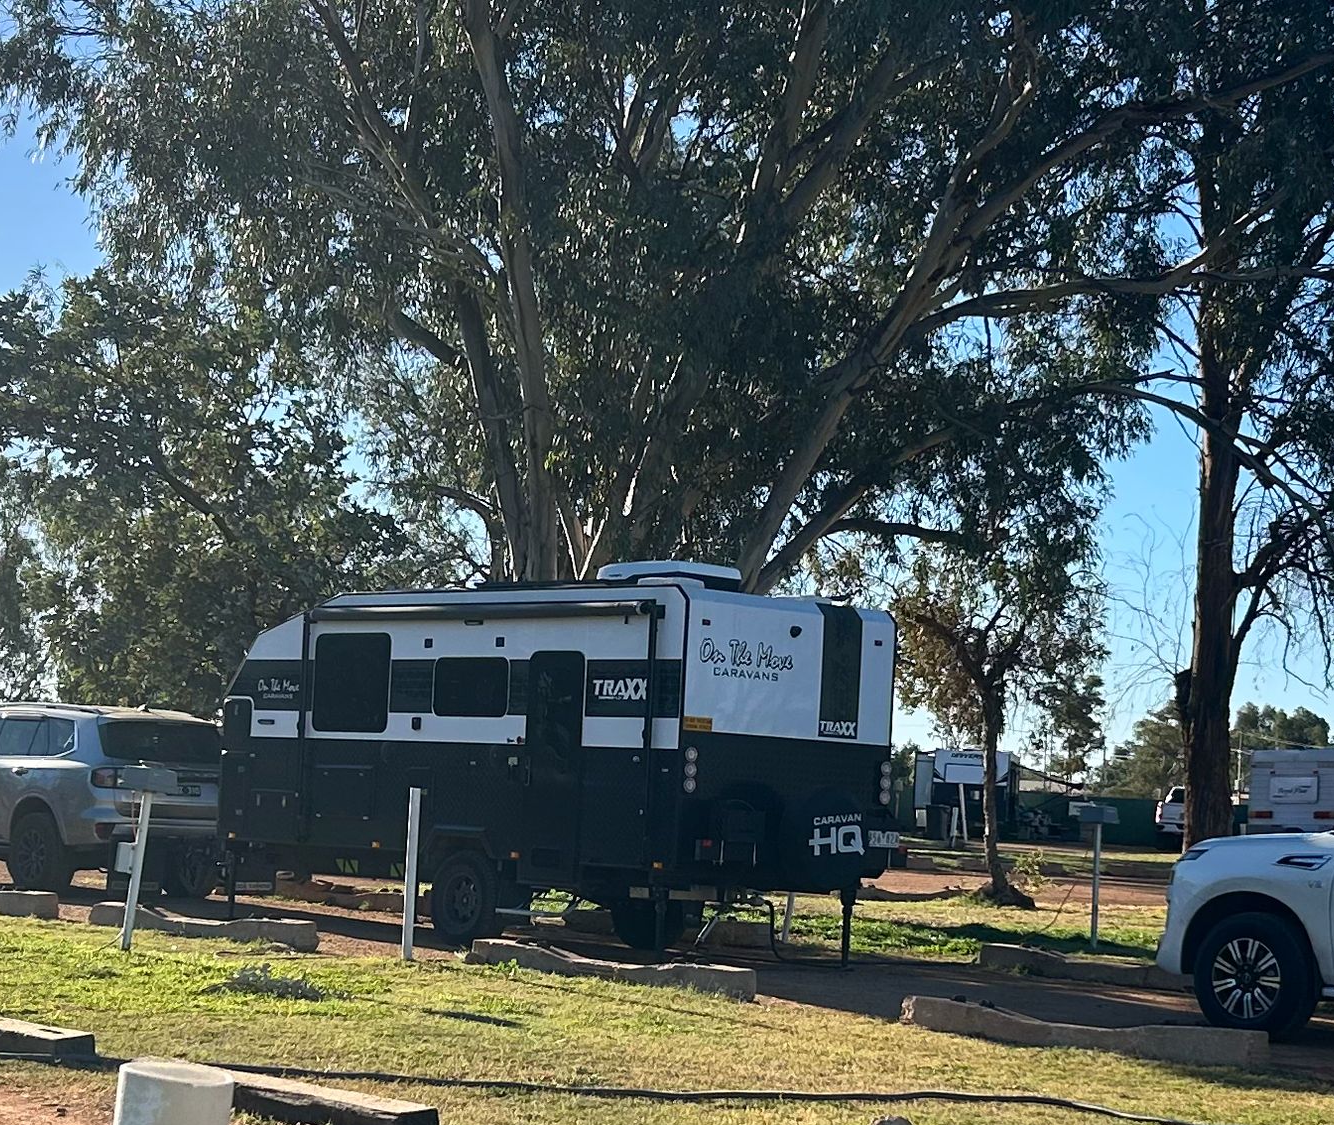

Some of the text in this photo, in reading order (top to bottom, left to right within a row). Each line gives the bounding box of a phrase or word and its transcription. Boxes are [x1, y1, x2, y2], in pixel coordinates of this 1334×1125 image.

[700, 637, 794, 671] On The Move
[713, 667, 779, 681] CARAVANS
[593, 678, 647, 700] TRAXX
[820, 720, 857, 737] TRAXX
[813, 813, 862, 826] CARAVAN
[809, 825, 865, 856] HQ
